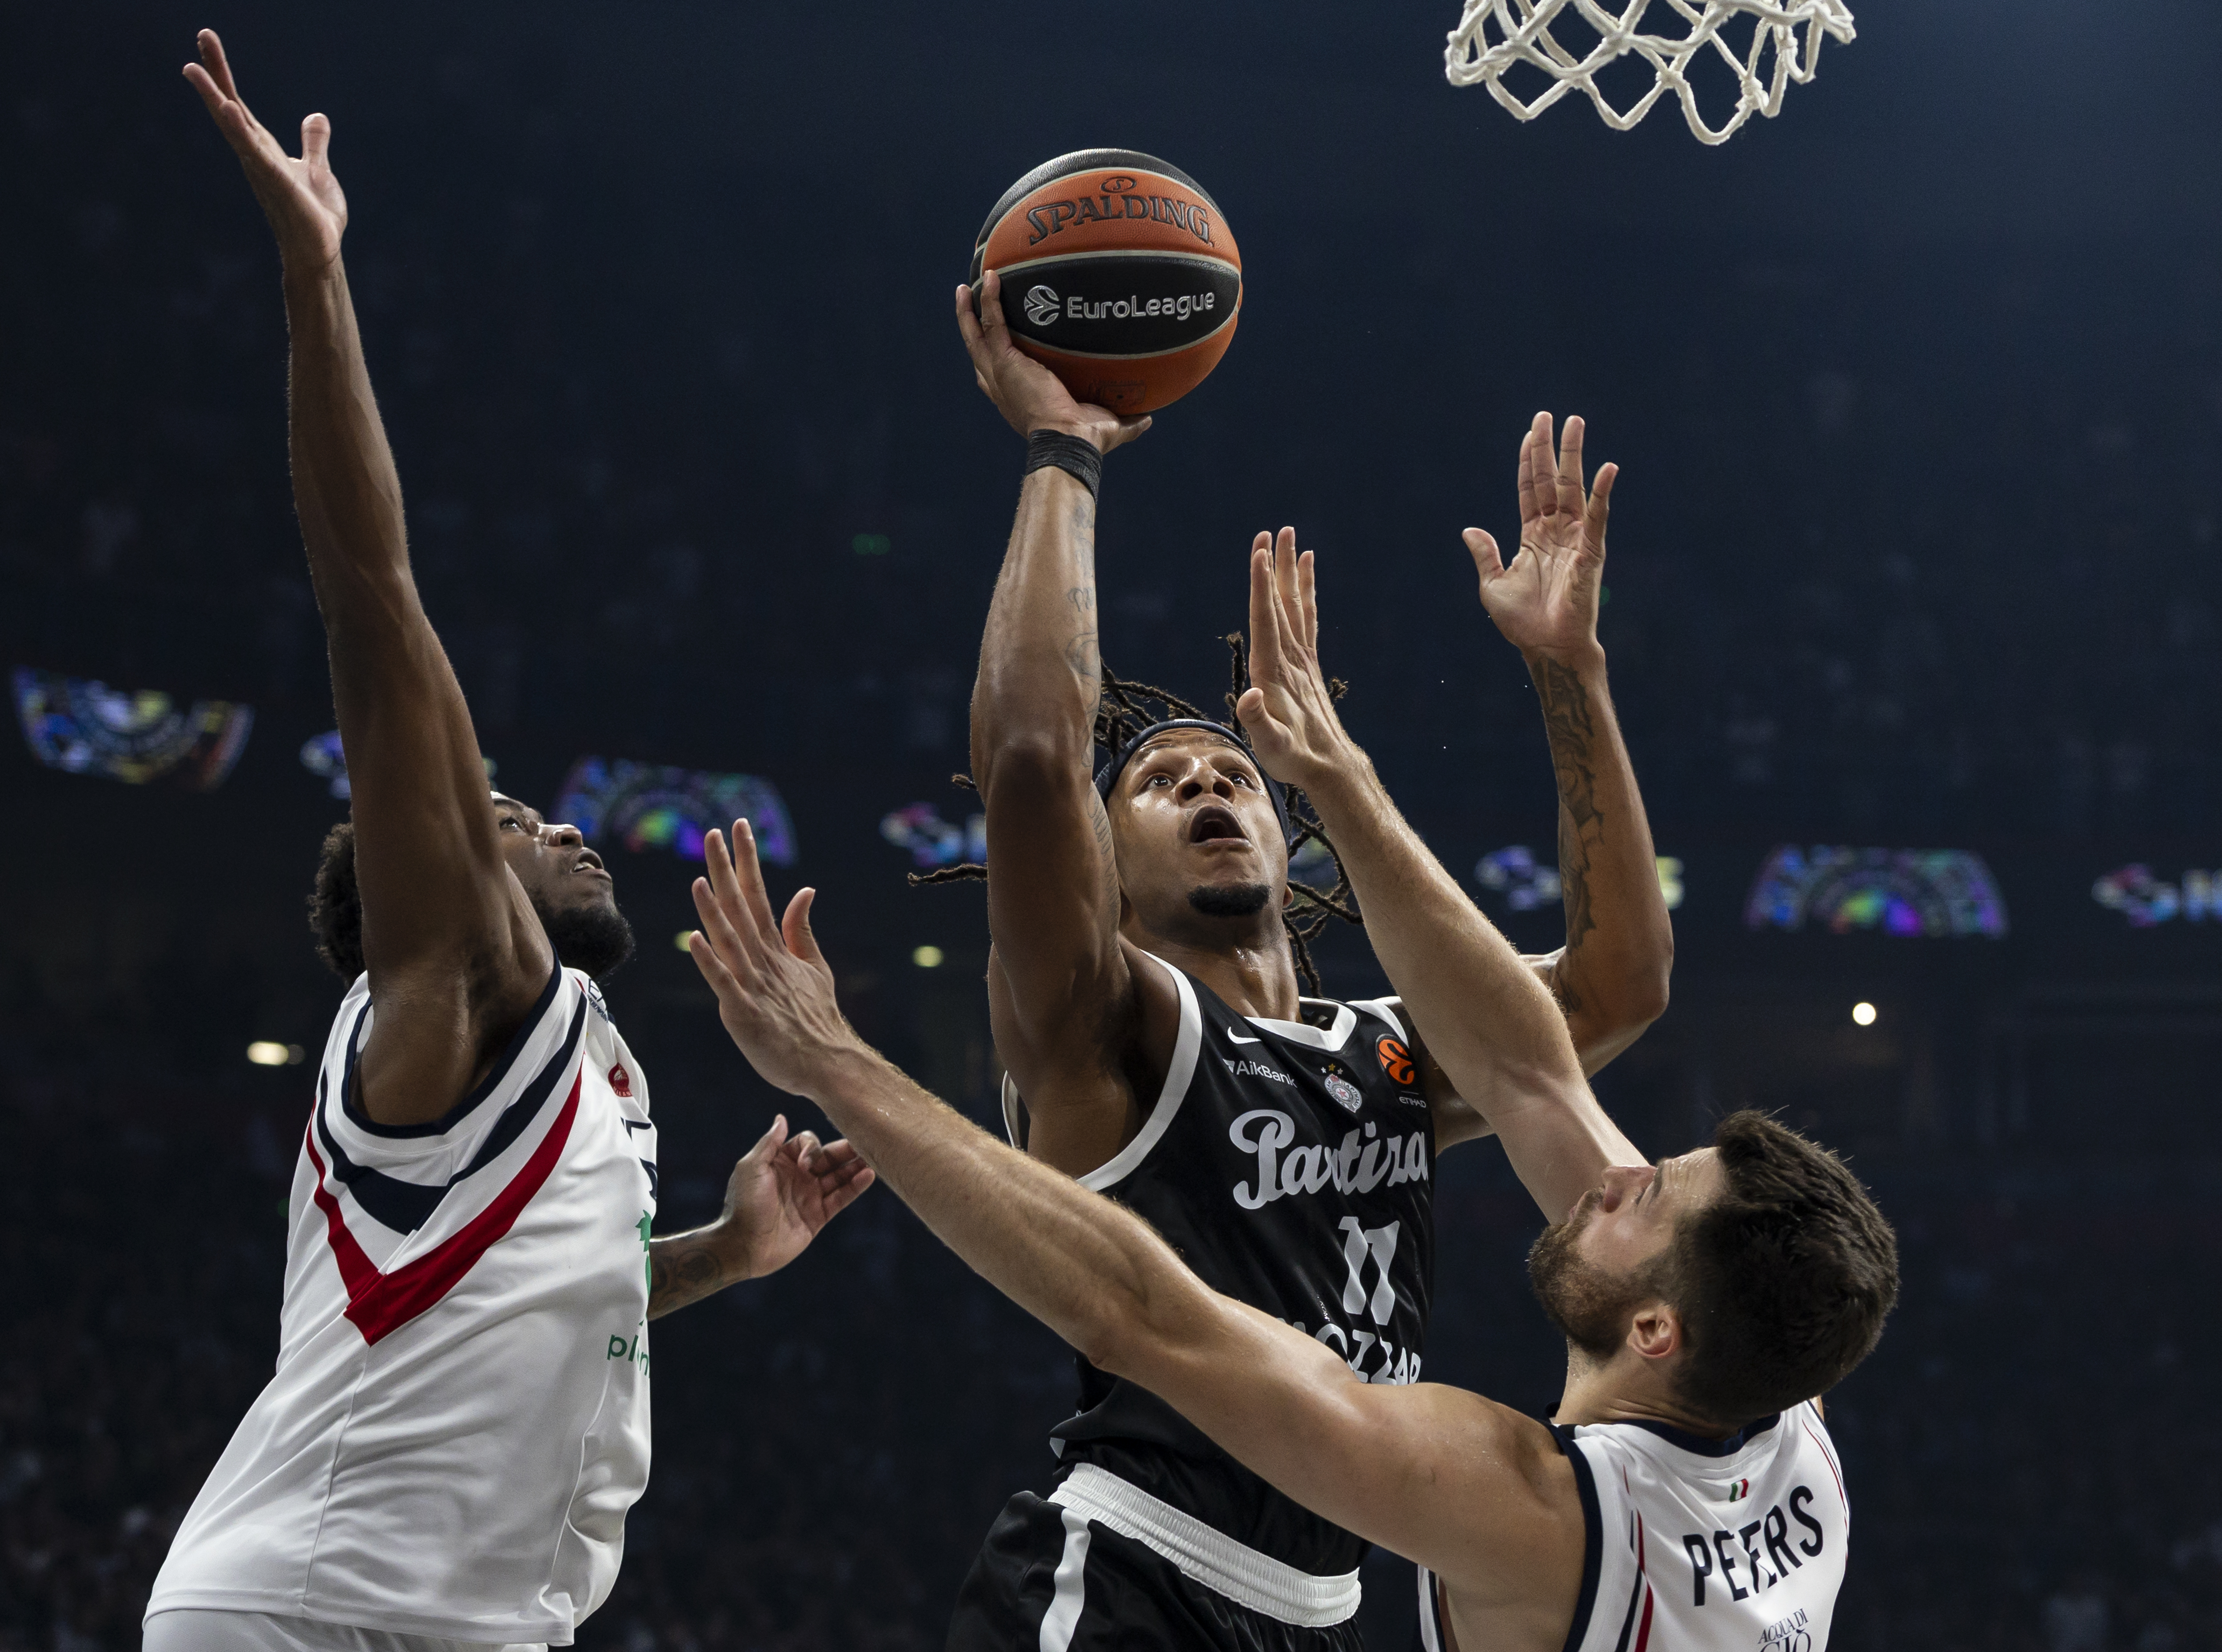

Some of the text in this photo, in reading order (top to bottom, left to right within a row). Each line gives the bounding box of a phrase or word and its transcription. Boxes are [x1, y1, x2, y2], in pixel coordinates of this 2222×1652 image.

[1027, 195, 1210, 246] SPALDING
[1067, 292, 1215, 320] EuroLeague
[1236, 1060, 1298, 1088] AikBank
[1229, 1109, 1428, 1210] Partiza
[607, 1334, 649, 1376] pln
[1758, 1608, 1809, 1644] ACQUA DI
